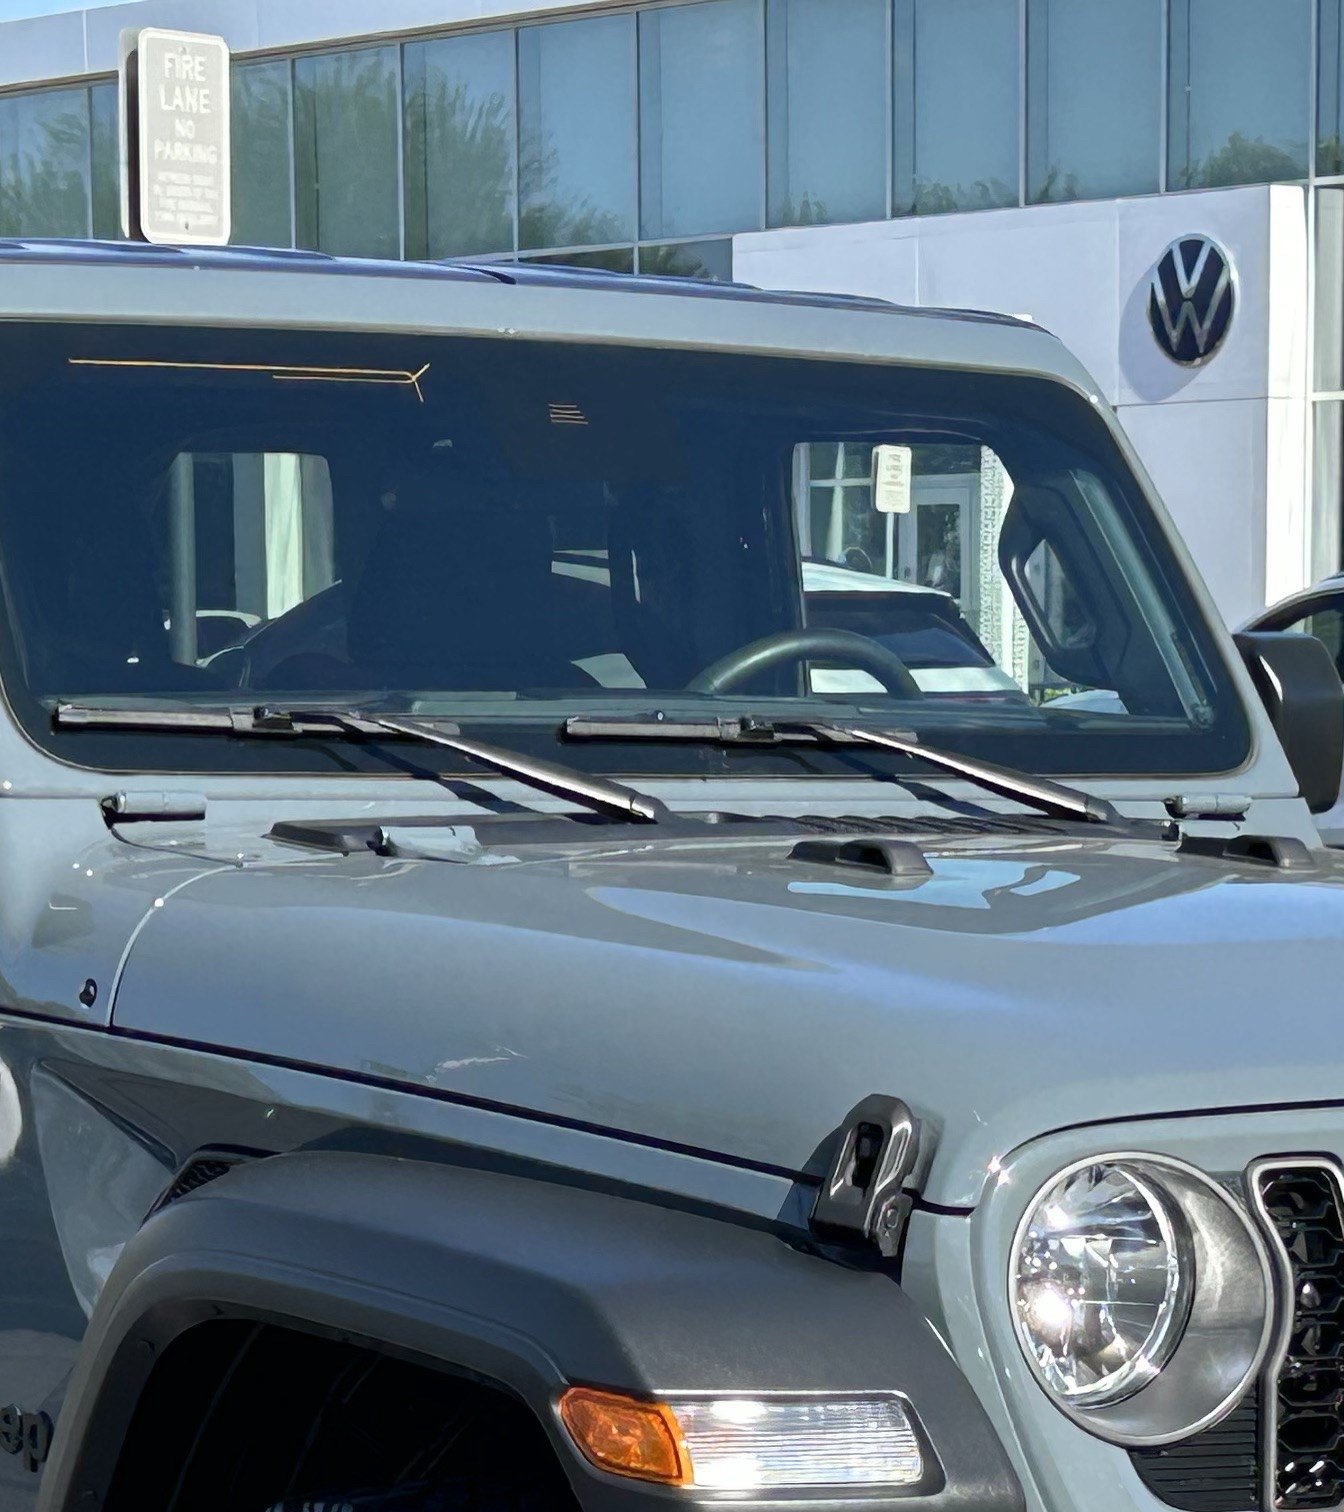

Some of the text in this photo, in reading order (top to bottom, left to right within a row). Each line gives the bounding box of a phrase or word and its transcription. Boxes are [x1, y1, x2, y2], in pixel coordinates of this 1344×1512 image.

[164, 53, 206, 81] FIRE
[159, 85, 211, 114] LANE
[174, 118, 196, 140] NO
[154, 139, 218, 165] PARKING
